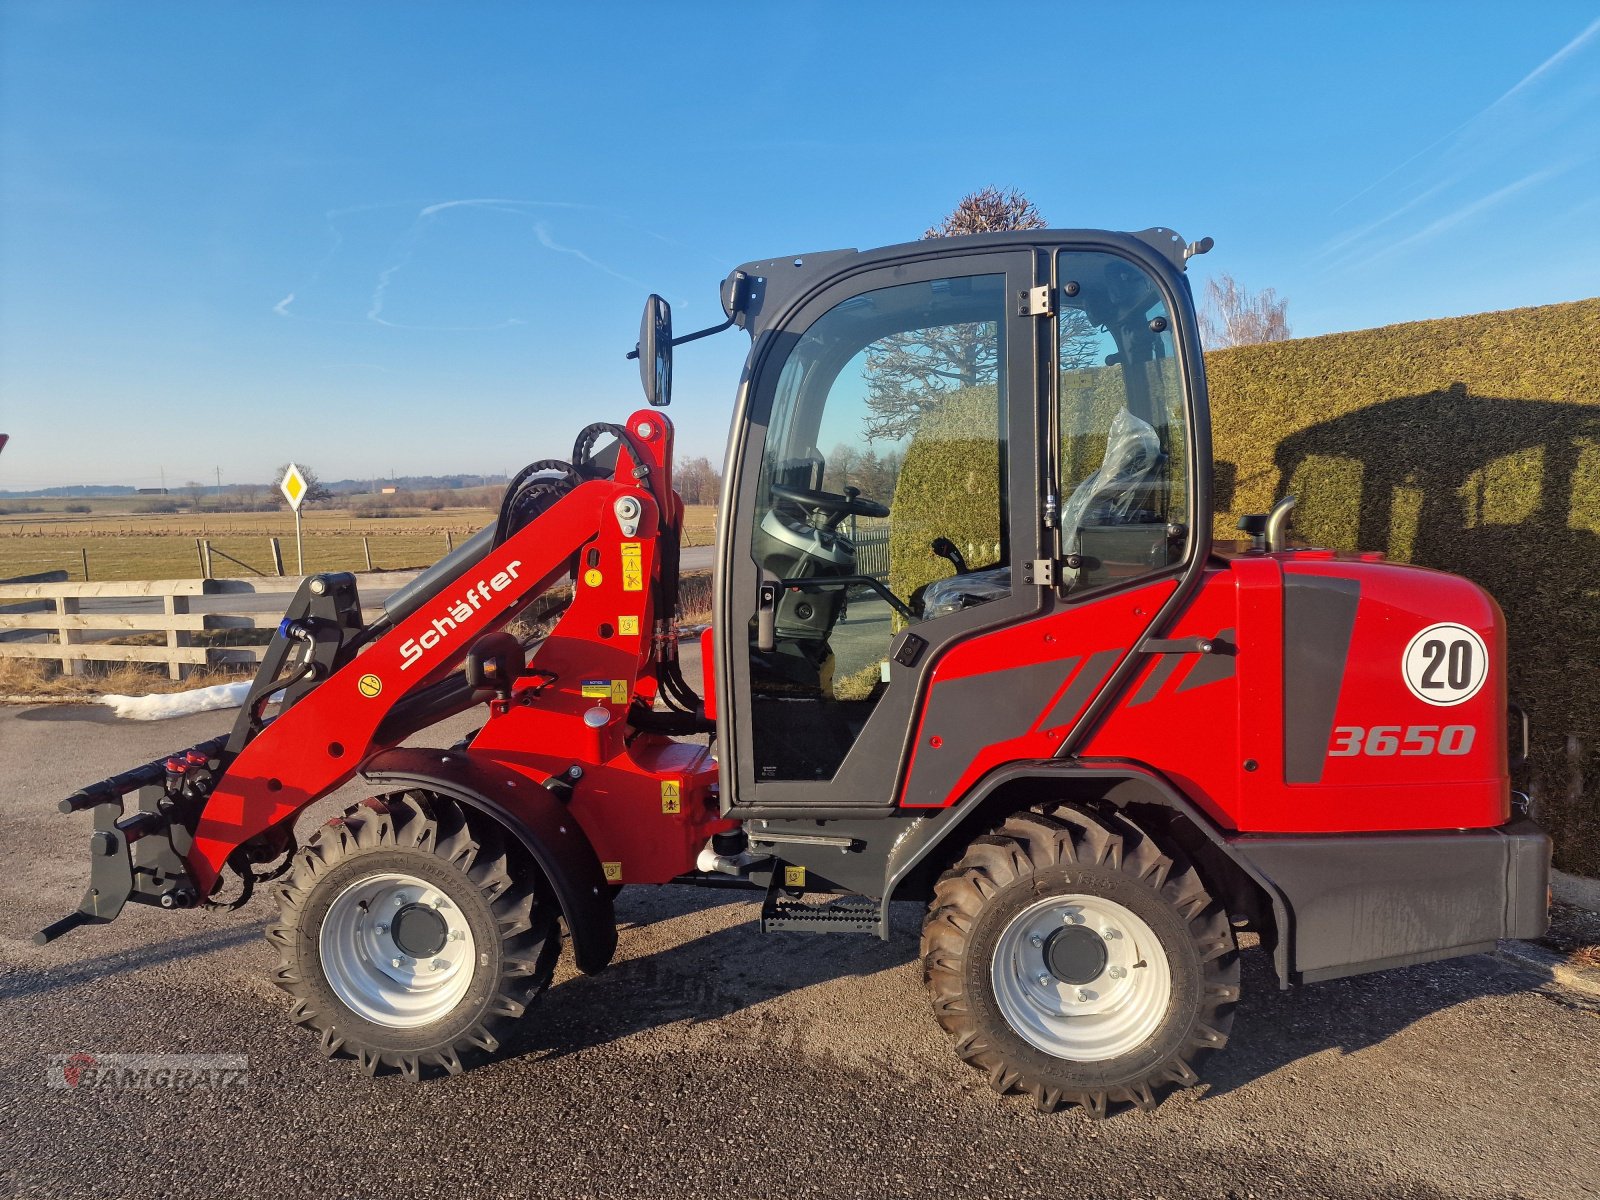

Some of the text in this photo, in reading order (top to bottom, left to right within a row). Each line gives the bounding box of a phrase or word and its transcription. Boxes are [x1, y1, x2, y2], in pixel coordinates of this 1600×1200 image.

[399, 559, 522, 671] Schäffer
[1420, 639, 1473, 690] 20
[1328, 725, 1476, 757] 3650
